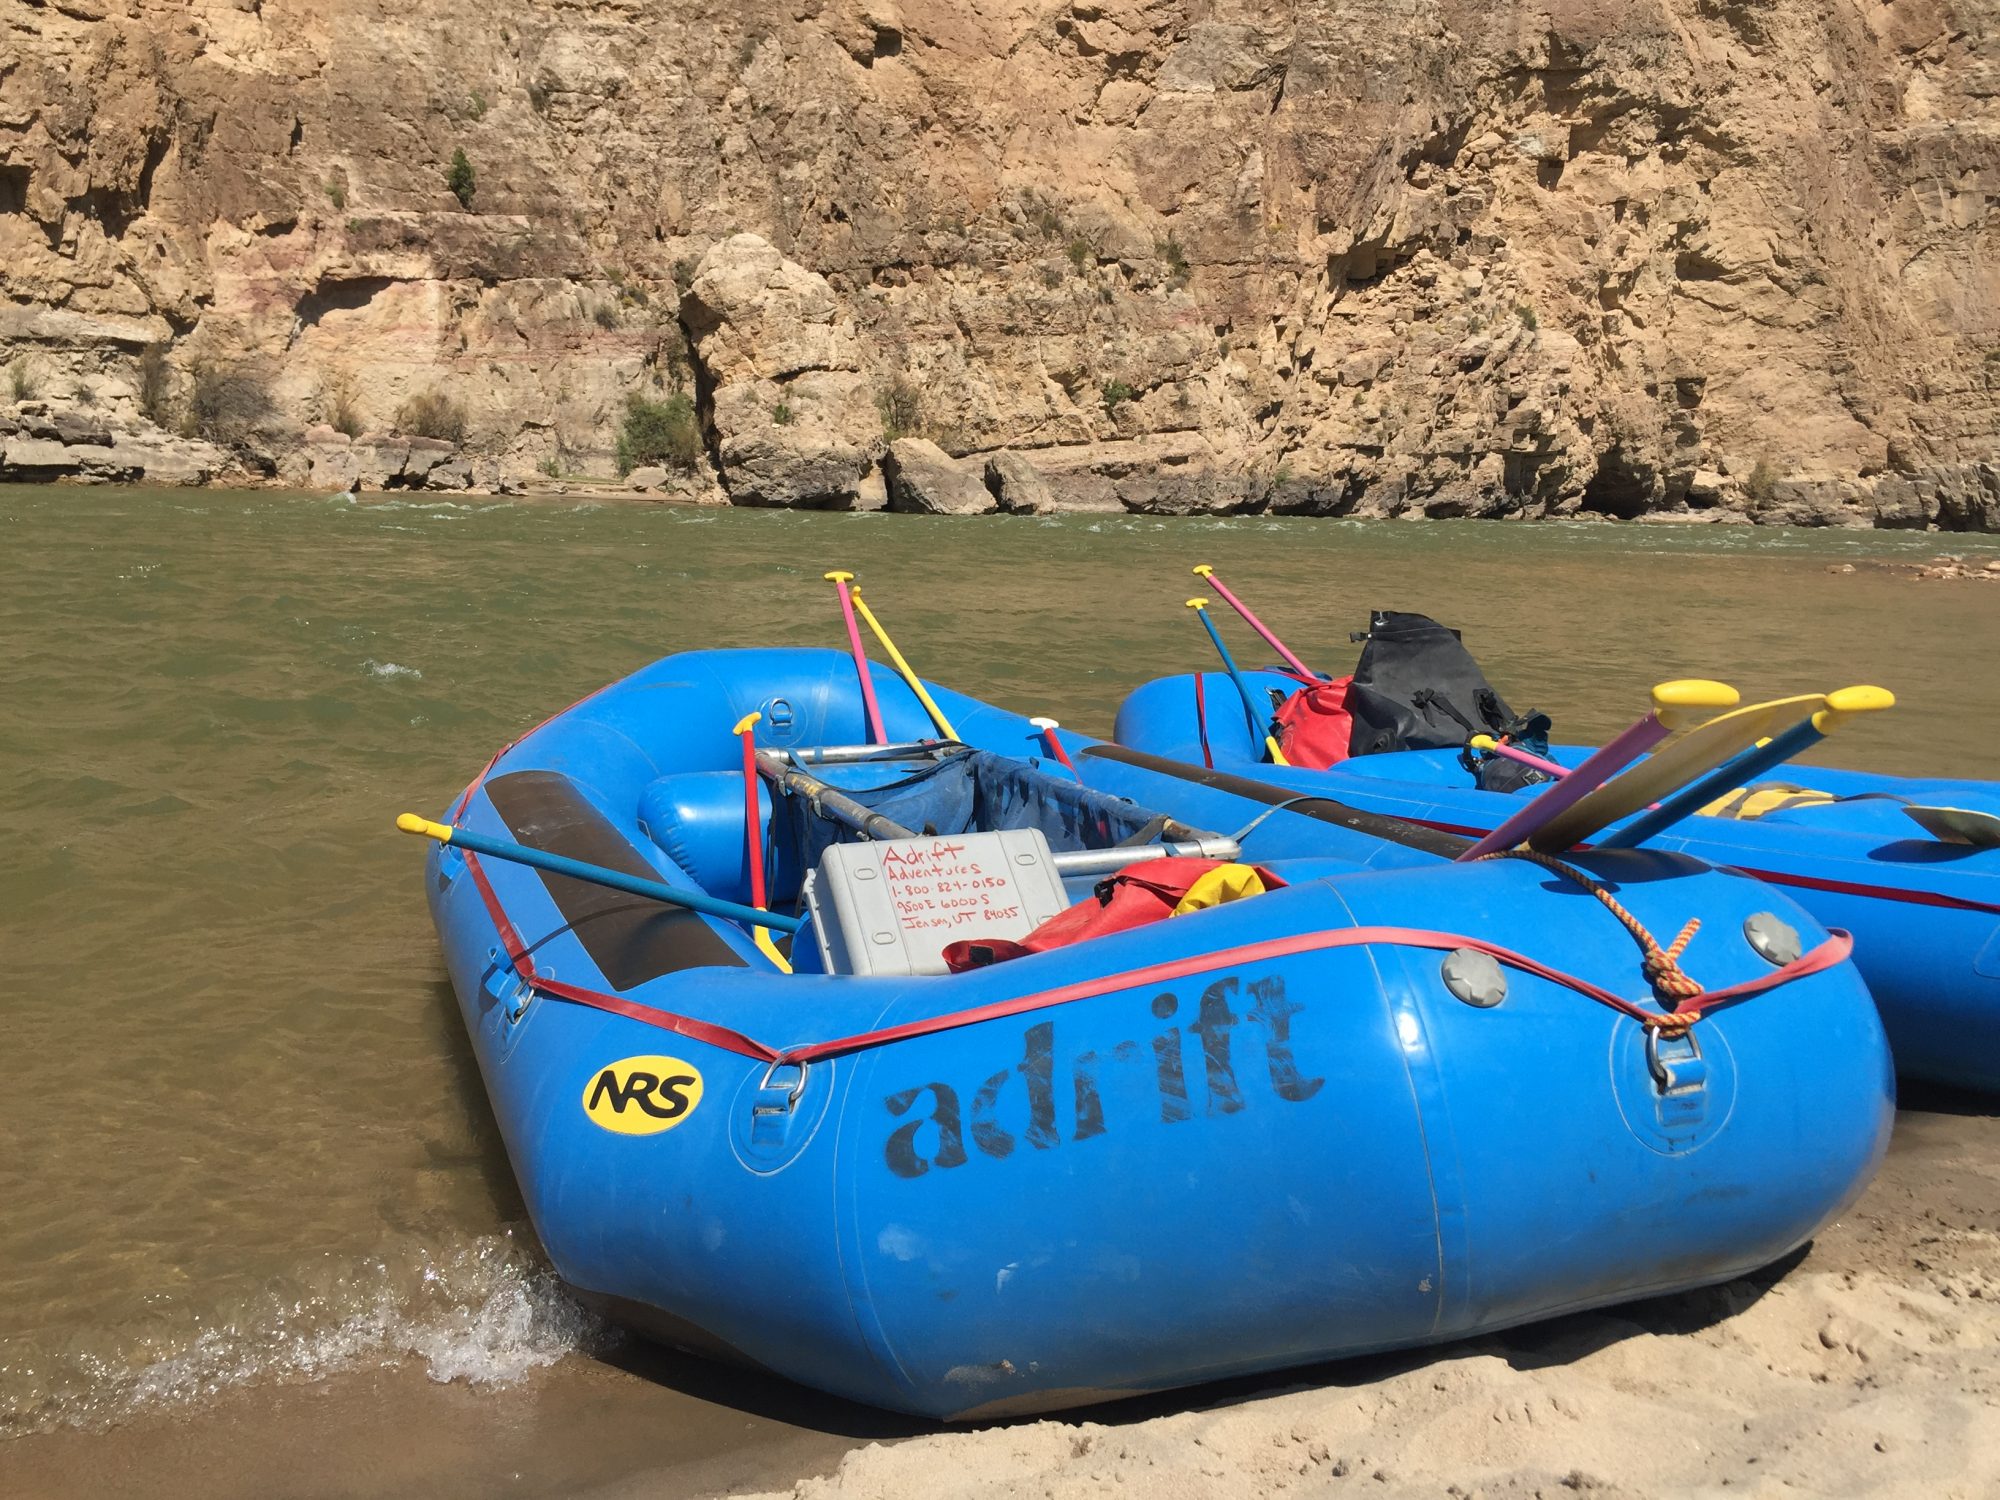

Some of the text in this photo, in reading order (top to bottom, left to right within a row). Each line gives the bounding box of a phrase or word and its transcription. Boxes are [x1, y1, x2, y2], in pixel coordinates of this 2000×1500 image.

[883, 841, 965, 866] Adrift
[888, 863, 982, 881] Adventures
[940, 898, 977, 909] 6000
[980, 893, 990, 905] S
[952, 911, 977, 924] UT
[983, 906, 1019, 921] 84035
[884, 976, 1325, 1178] adrift
[588, 1070, 697, 1119] NRS
